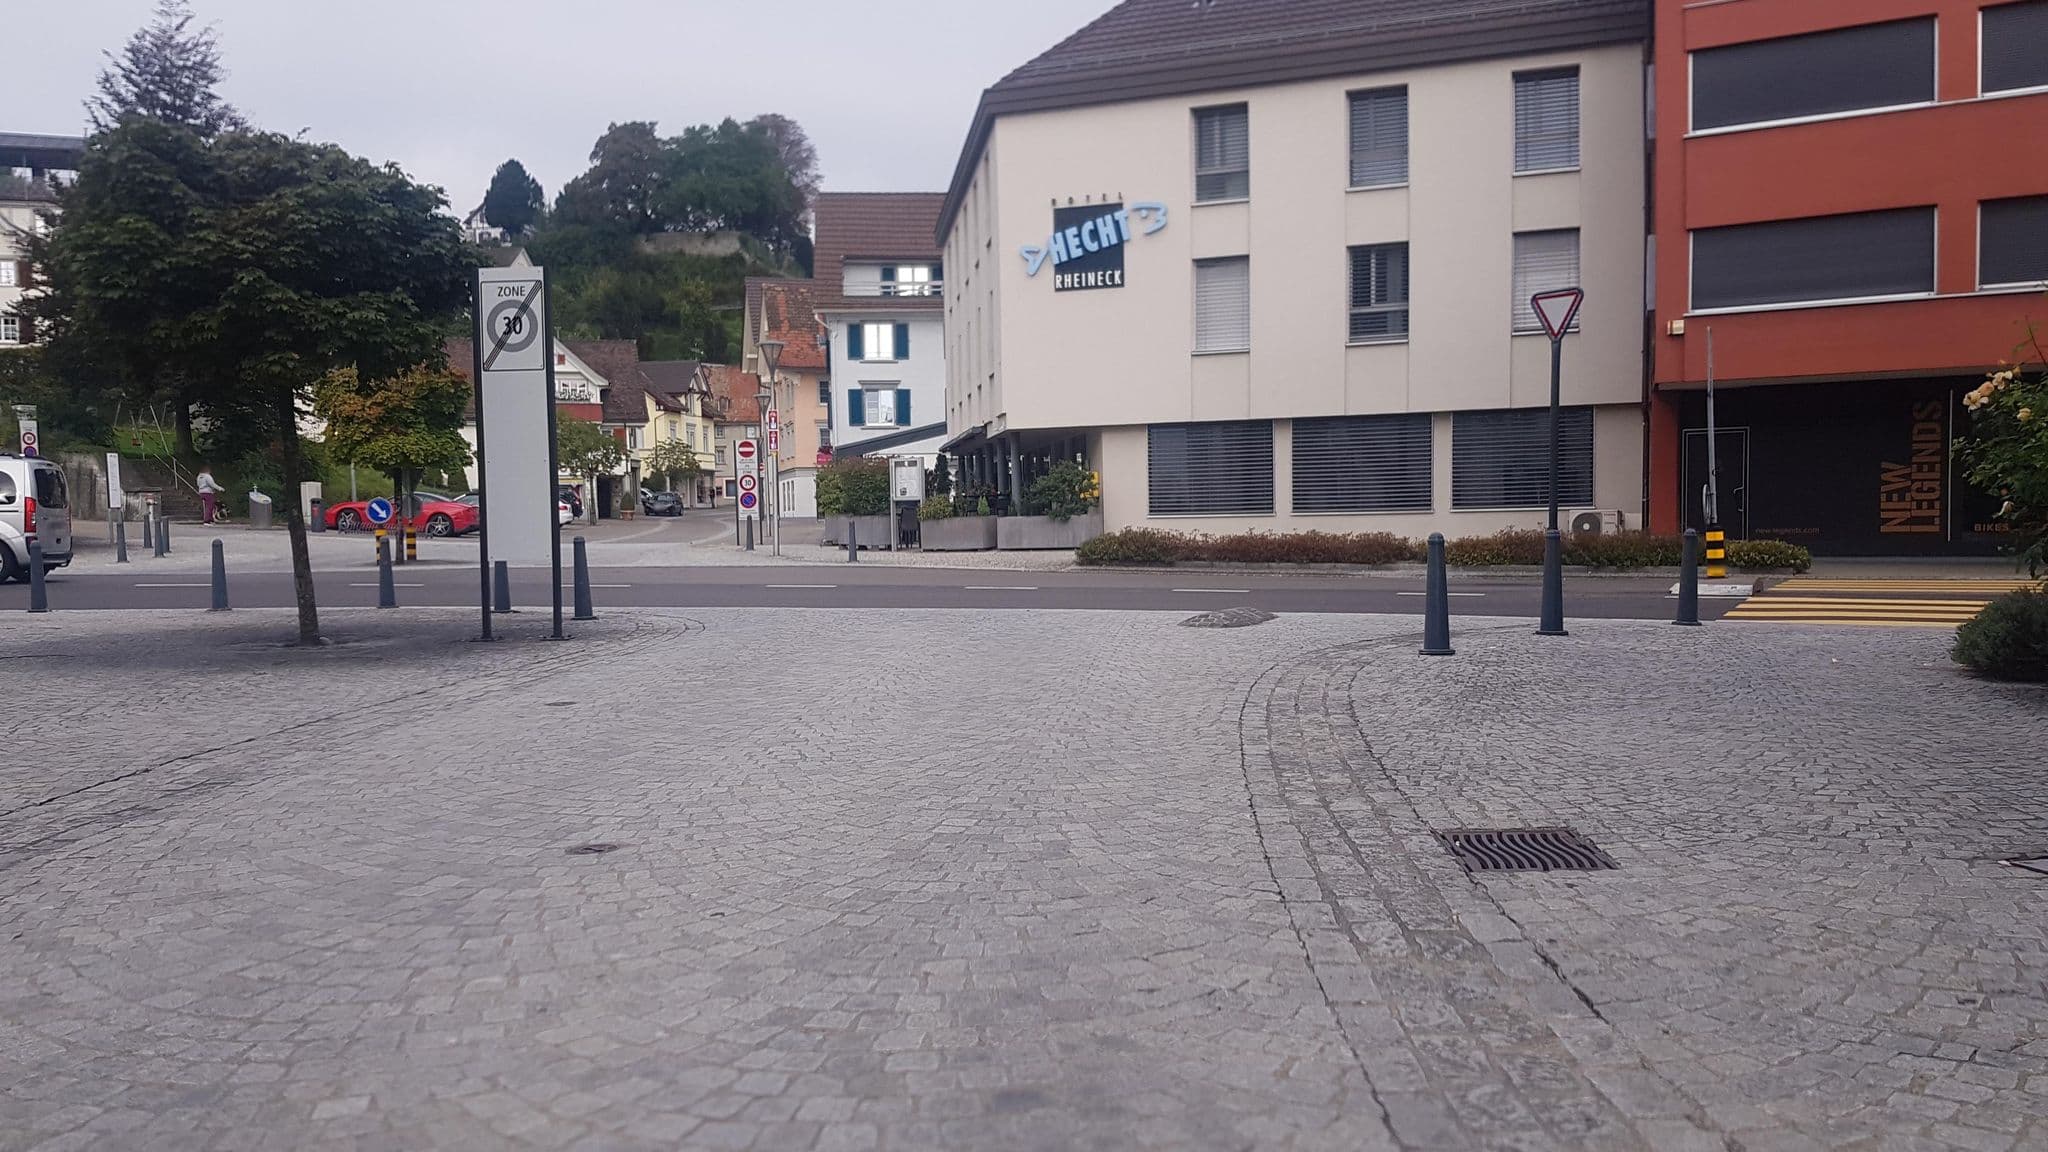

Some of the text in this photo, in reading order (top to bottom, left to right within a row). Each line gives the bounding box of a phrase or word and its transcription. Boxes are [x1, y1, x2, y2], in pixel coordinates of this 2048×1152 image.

[1047, 208, 1131, 265] HECHT
[1055, 270, 1122, 289] RHEINECK
[498, 286, 526, 297] ZONE
[503, 316, 523, 335] 30
[1911, 401, 1942, 533] LEGENDS
[1880, 461, 1911, 533] NEW
[1974, 523, 2009, 532] BIKES
